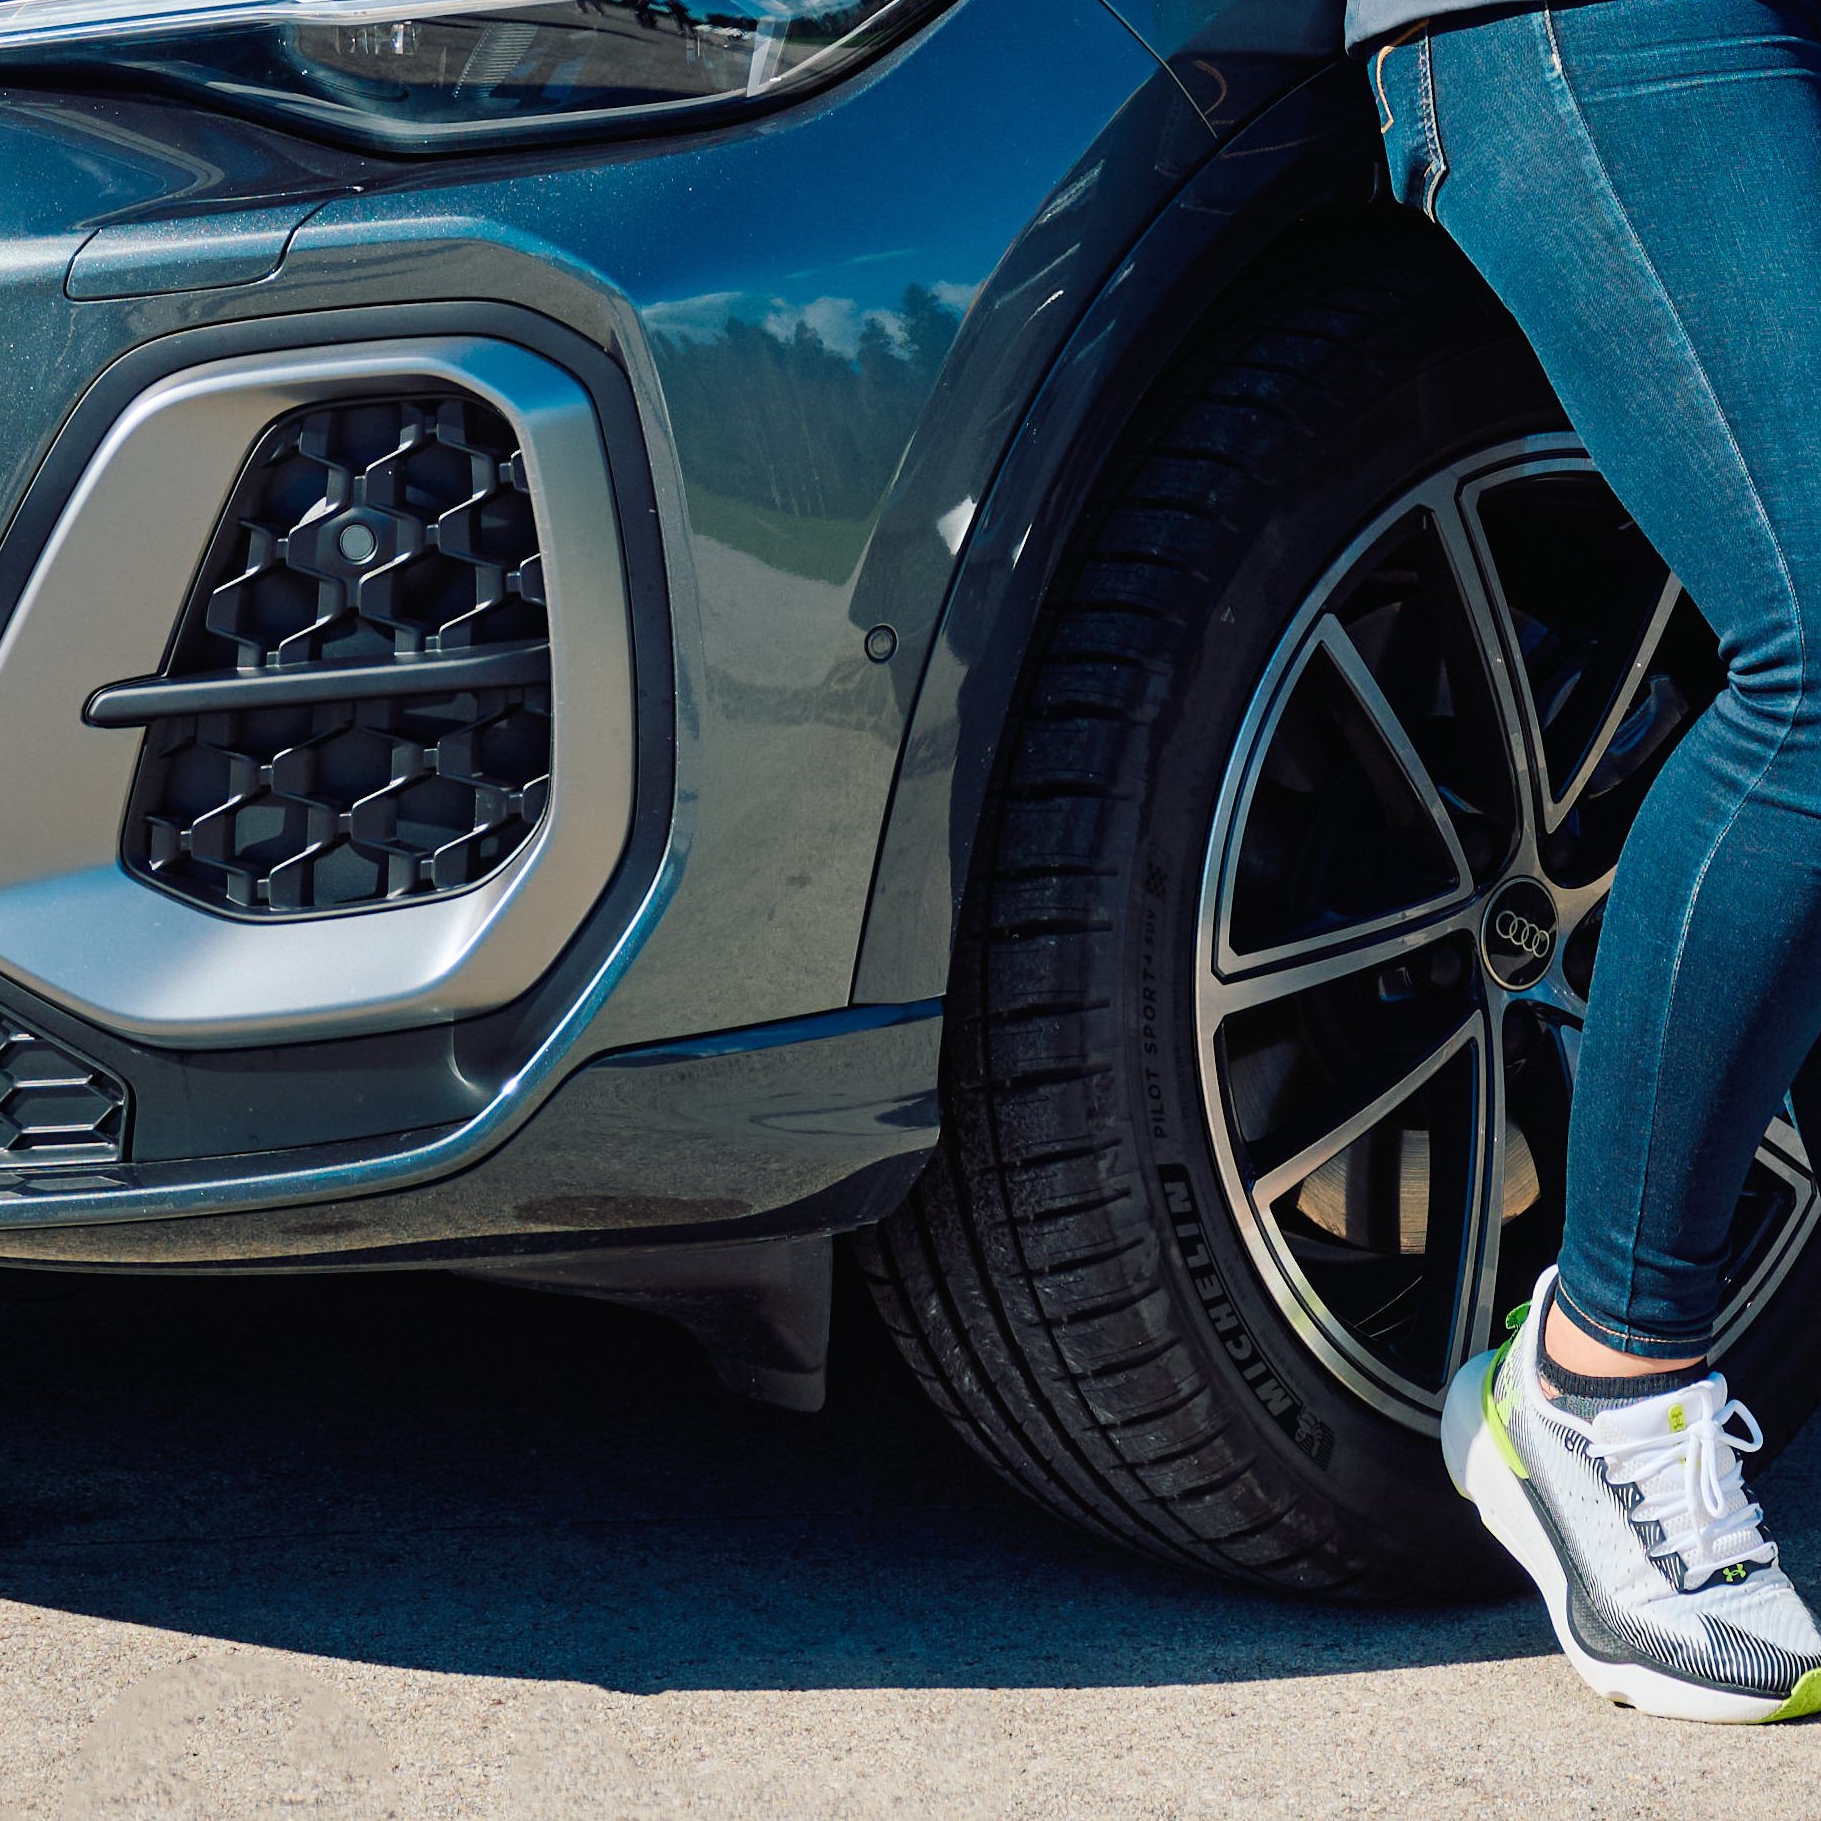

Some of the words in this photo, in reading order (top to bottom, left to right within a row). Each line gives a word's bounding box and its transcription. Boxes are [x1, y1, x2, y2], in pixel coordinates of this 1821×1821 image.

[1143, 908, 1156, 948] SUV
[1143, 968, 1158, 1055] SPORT
[1146, 1069, 1167, 1139] PILOT
[1163, 1180, 1293, 1418] MICHELIN
